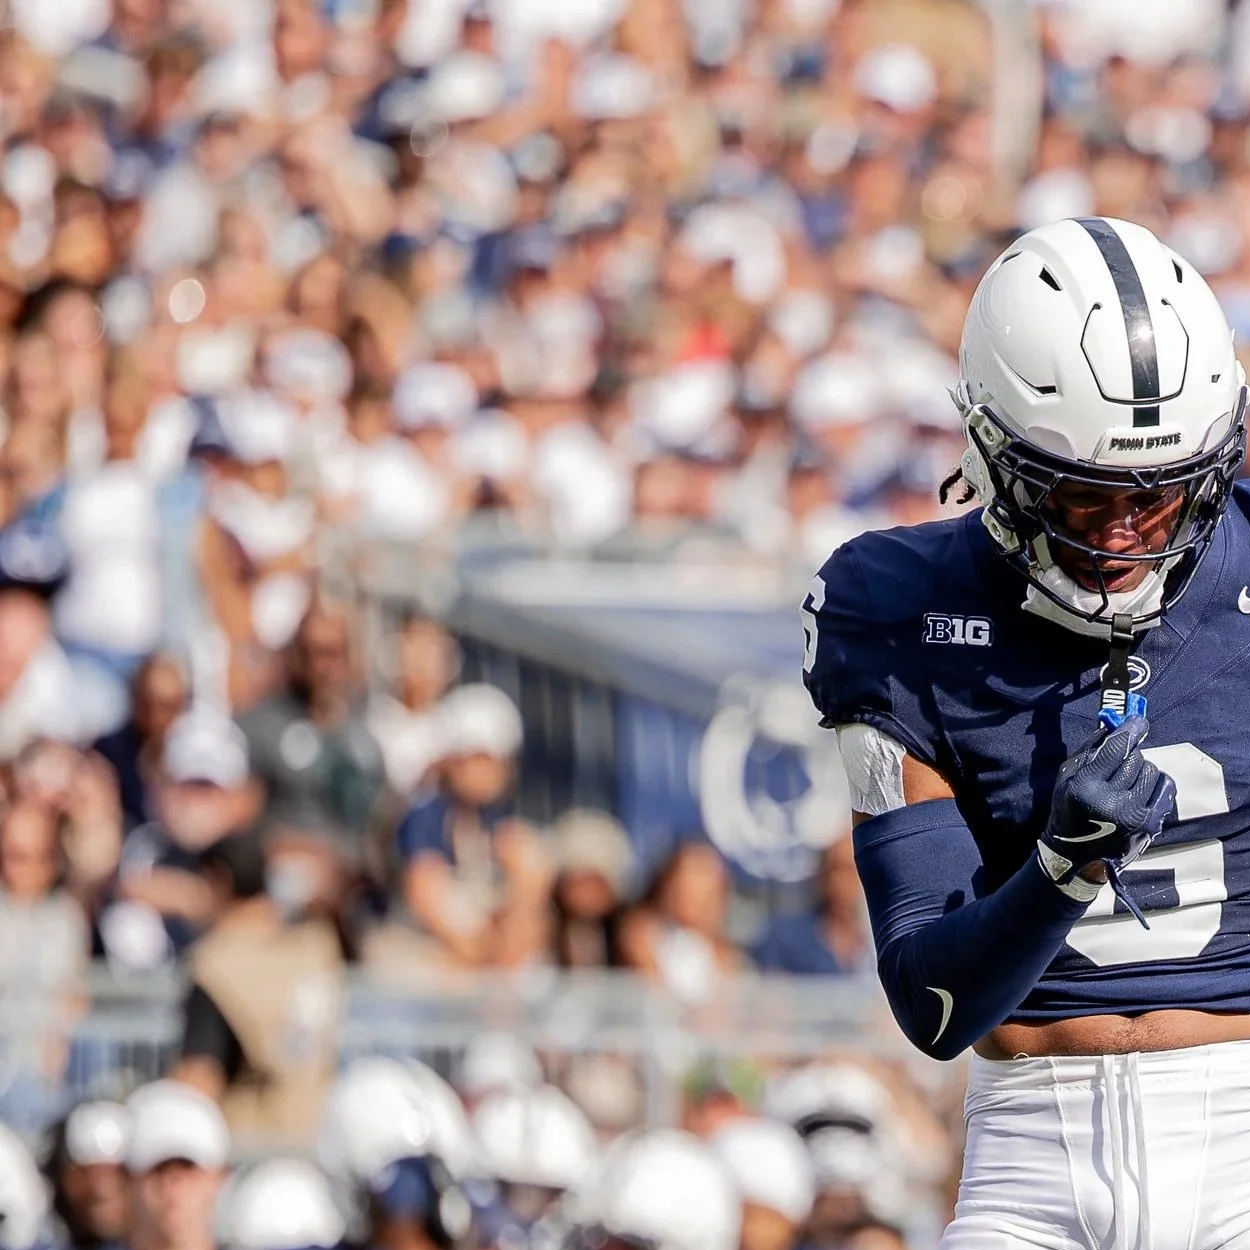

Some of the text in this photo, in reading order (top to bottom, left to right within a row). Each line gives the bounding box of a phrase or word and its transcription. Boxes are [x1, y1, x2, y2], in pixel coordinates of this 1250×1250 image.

[1109, 432, 1181, 451] PENN STATE
[801, 574, 826, 674] 6
